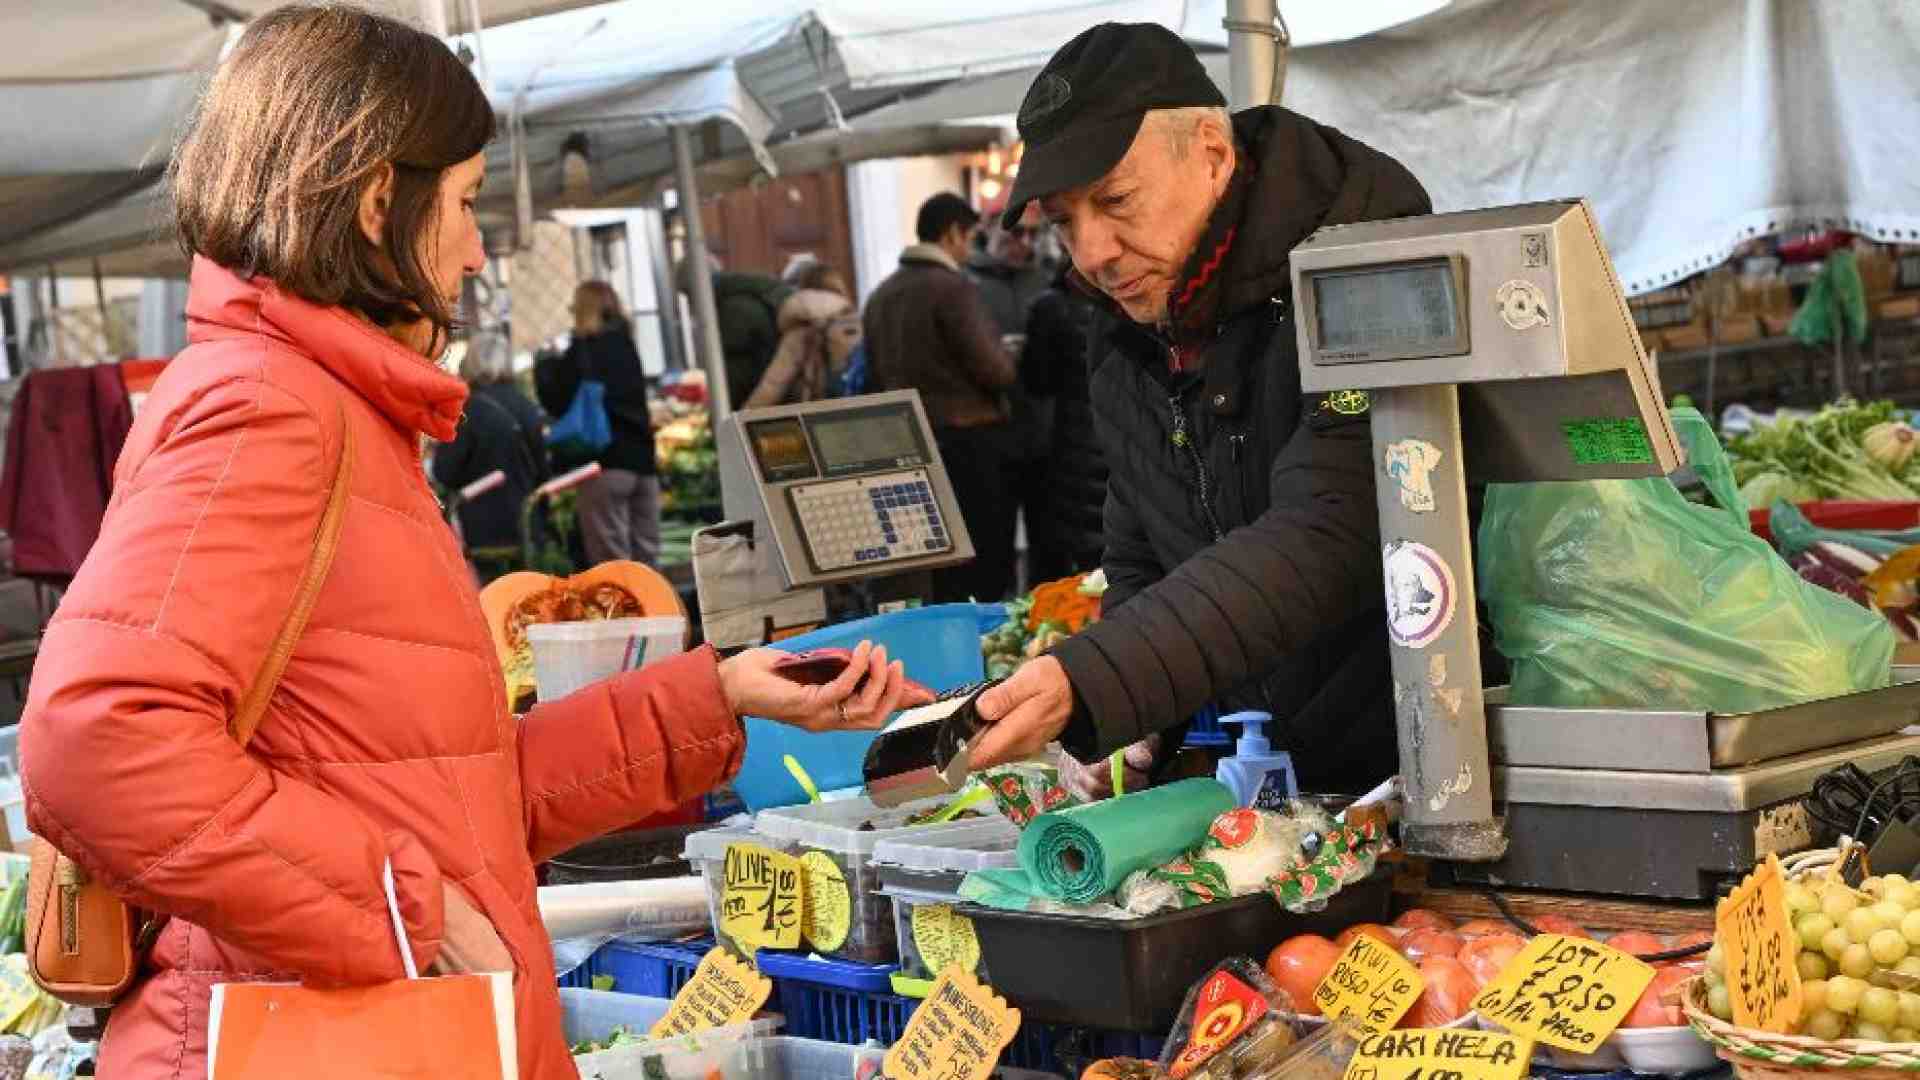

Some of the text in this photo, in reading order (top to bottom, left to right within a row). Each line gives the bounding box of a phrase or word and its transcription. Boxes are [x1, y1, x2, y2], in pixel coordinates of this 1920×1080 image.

[723, 846, 773, 886] OLIVE
[1348, 939, 1390, 974] KIWI
[1534, 937, 1608, 974] LOTI
[1359, 1032, 1517, 1066] CAKI MELA
